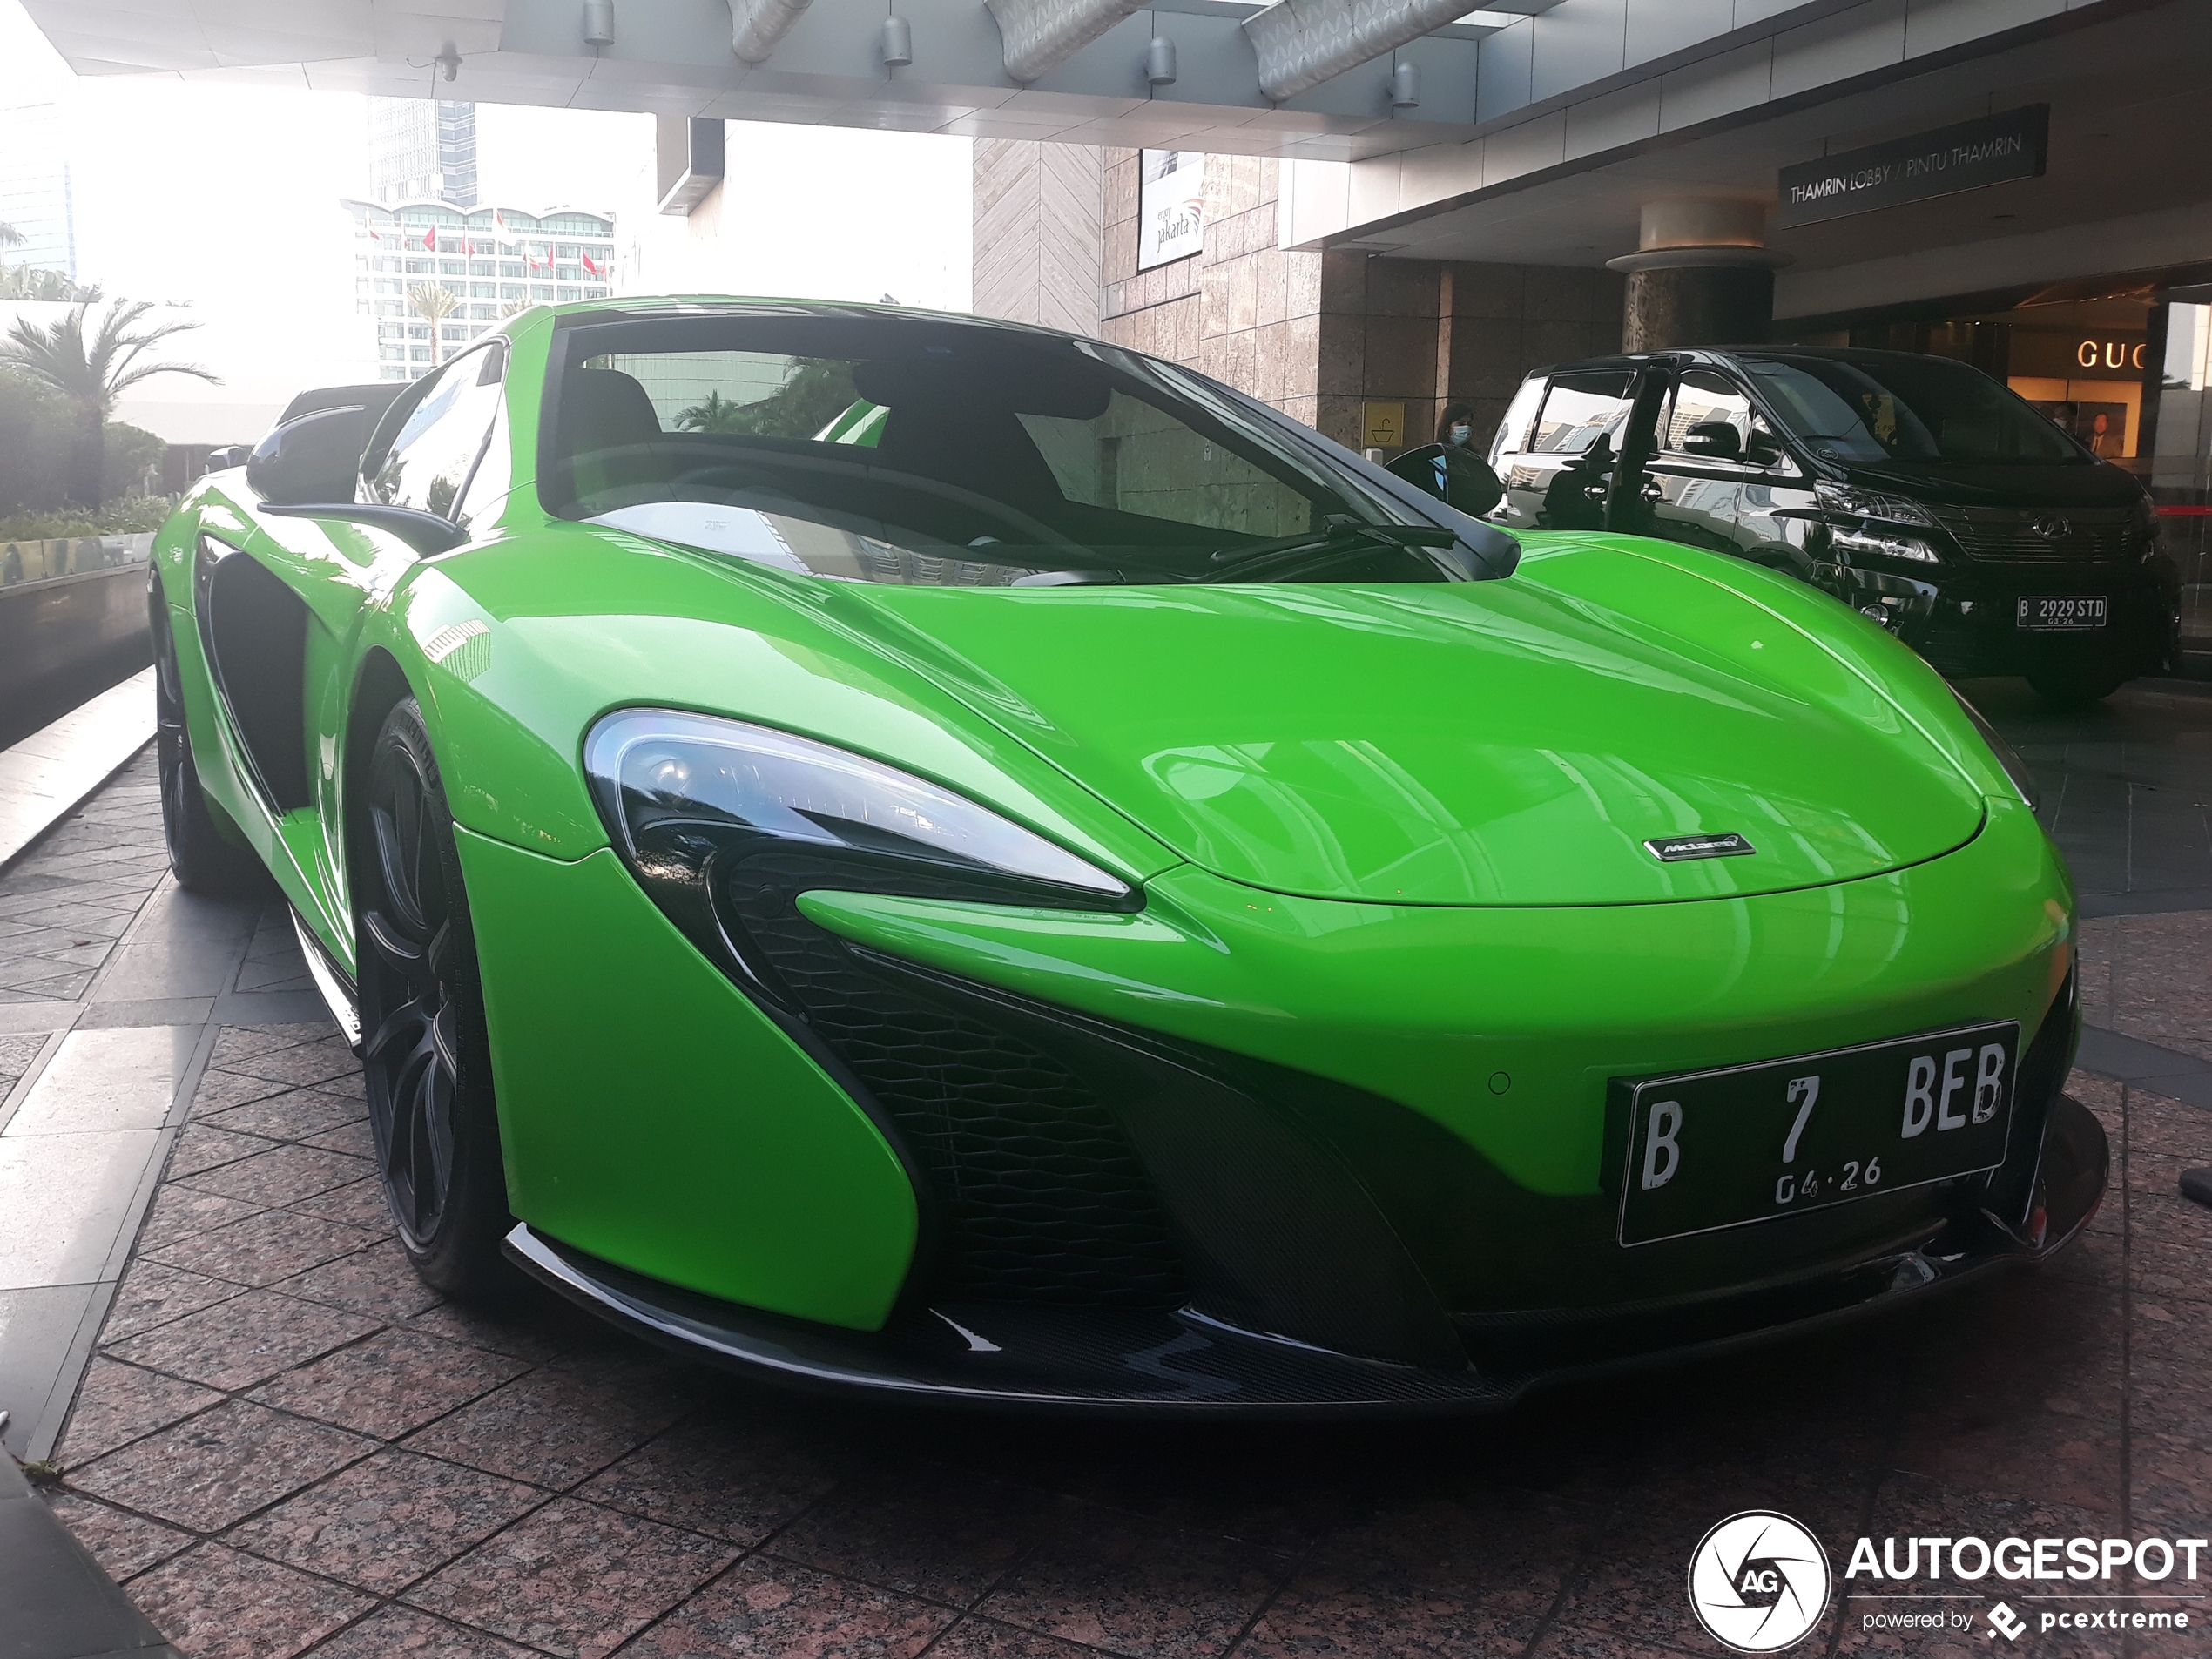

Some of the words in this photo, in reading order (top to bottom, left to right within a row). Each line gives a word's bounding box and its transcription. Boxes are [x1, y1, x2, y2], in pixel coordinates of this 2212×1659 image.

[1791, 174, 1846, 204] THAMRIN
[1850, 165, 1892, 191] LOBBY
[1906, 151, 1947, 178] PINTU
[1952, 132, 2021, 166] THAMRIN
[1157, 206, 1172, 222] enjoy
[1157, 212, 1190, 254] jakarta
[2020, 599, 2029, 617] B
[2039, 599, 2075, 617] 2929
[2077, 599, 2104, 617] STD
[1663, 837, 1738, 853] McLaren
[1642, 1100, 1683, 1190] B
[1782, 1076, 1821, 1163] 7
[1900, 1042, 2006, 1139] BEB
